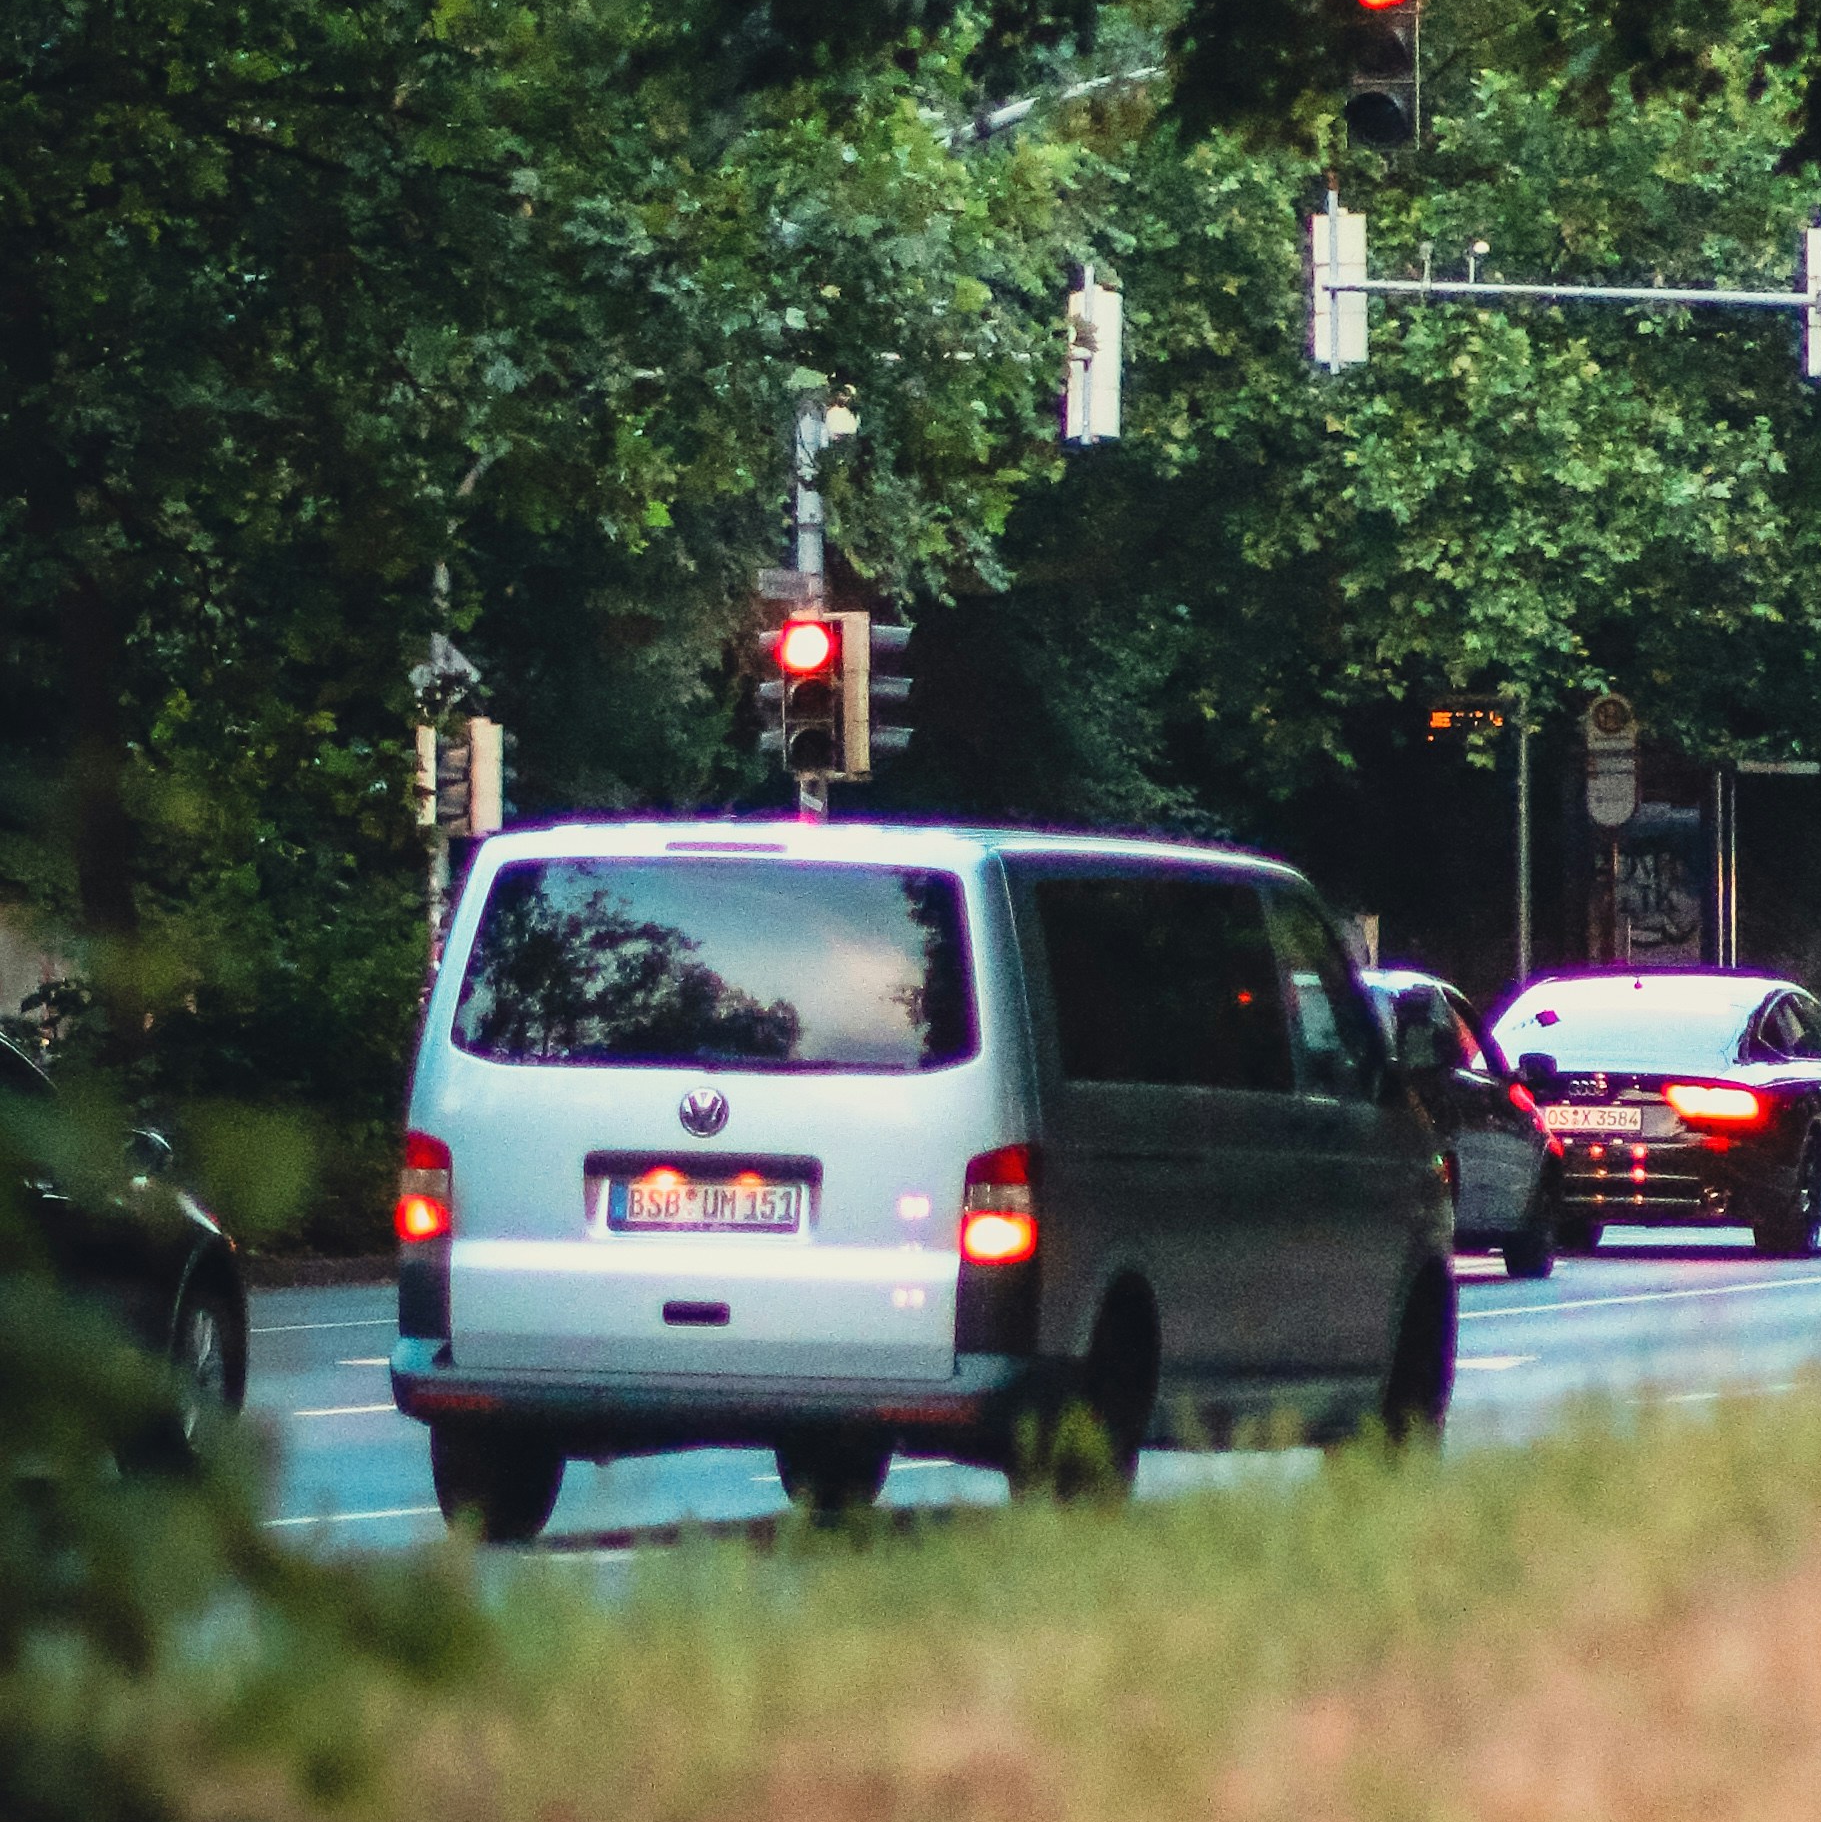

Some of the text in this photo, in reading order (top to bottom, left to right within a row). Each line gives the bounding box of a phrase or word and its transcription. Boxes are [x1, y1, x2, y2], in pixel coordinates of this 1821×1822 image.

[1547, 1109, 1639, 1127] OS X 3584
[629, 1188, 681, 1219] BSB
[743, 1189, 795, 1221] 151
